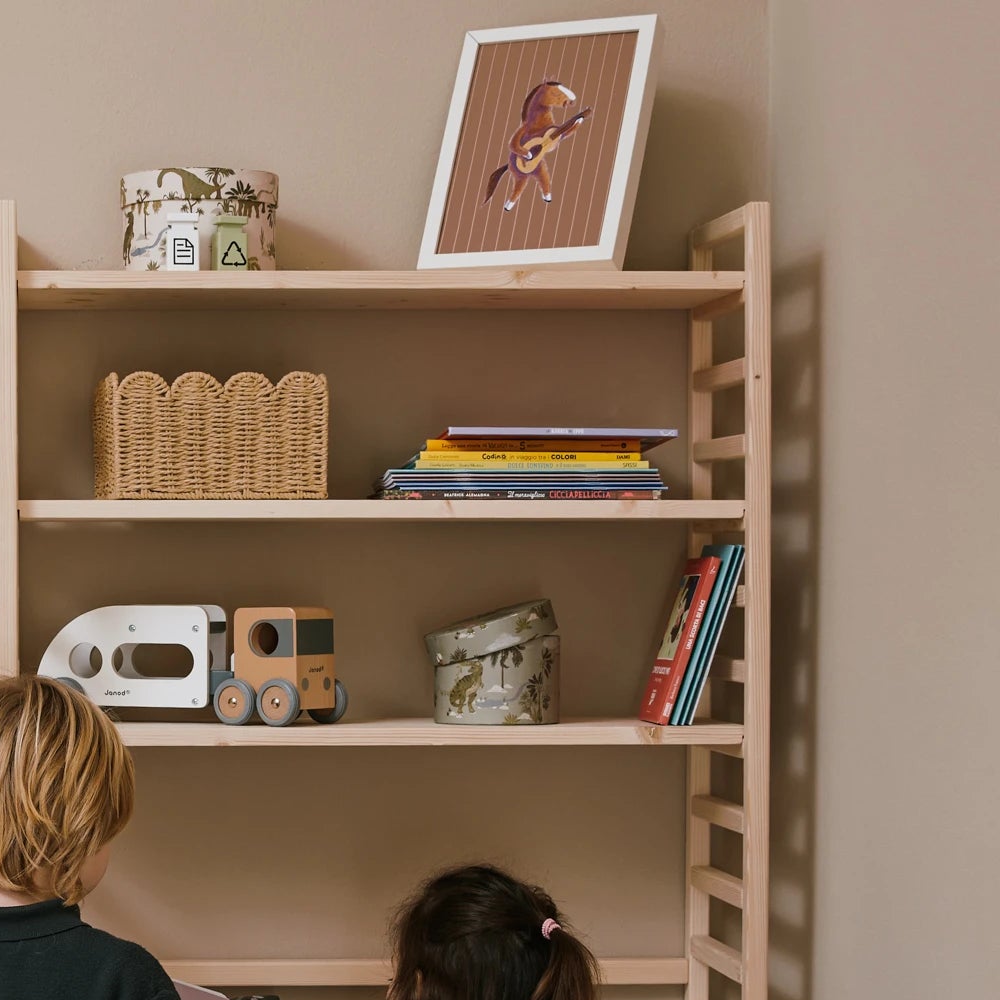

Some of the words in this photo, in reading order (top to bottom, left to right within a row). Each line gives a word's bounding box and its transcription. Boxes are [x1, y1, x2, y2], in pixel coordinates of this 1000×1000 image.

[517, 453, 538, 462] viaggio
[691, 618, 700, 637] SCORTA
[104, 689, 127, 697] Janod
